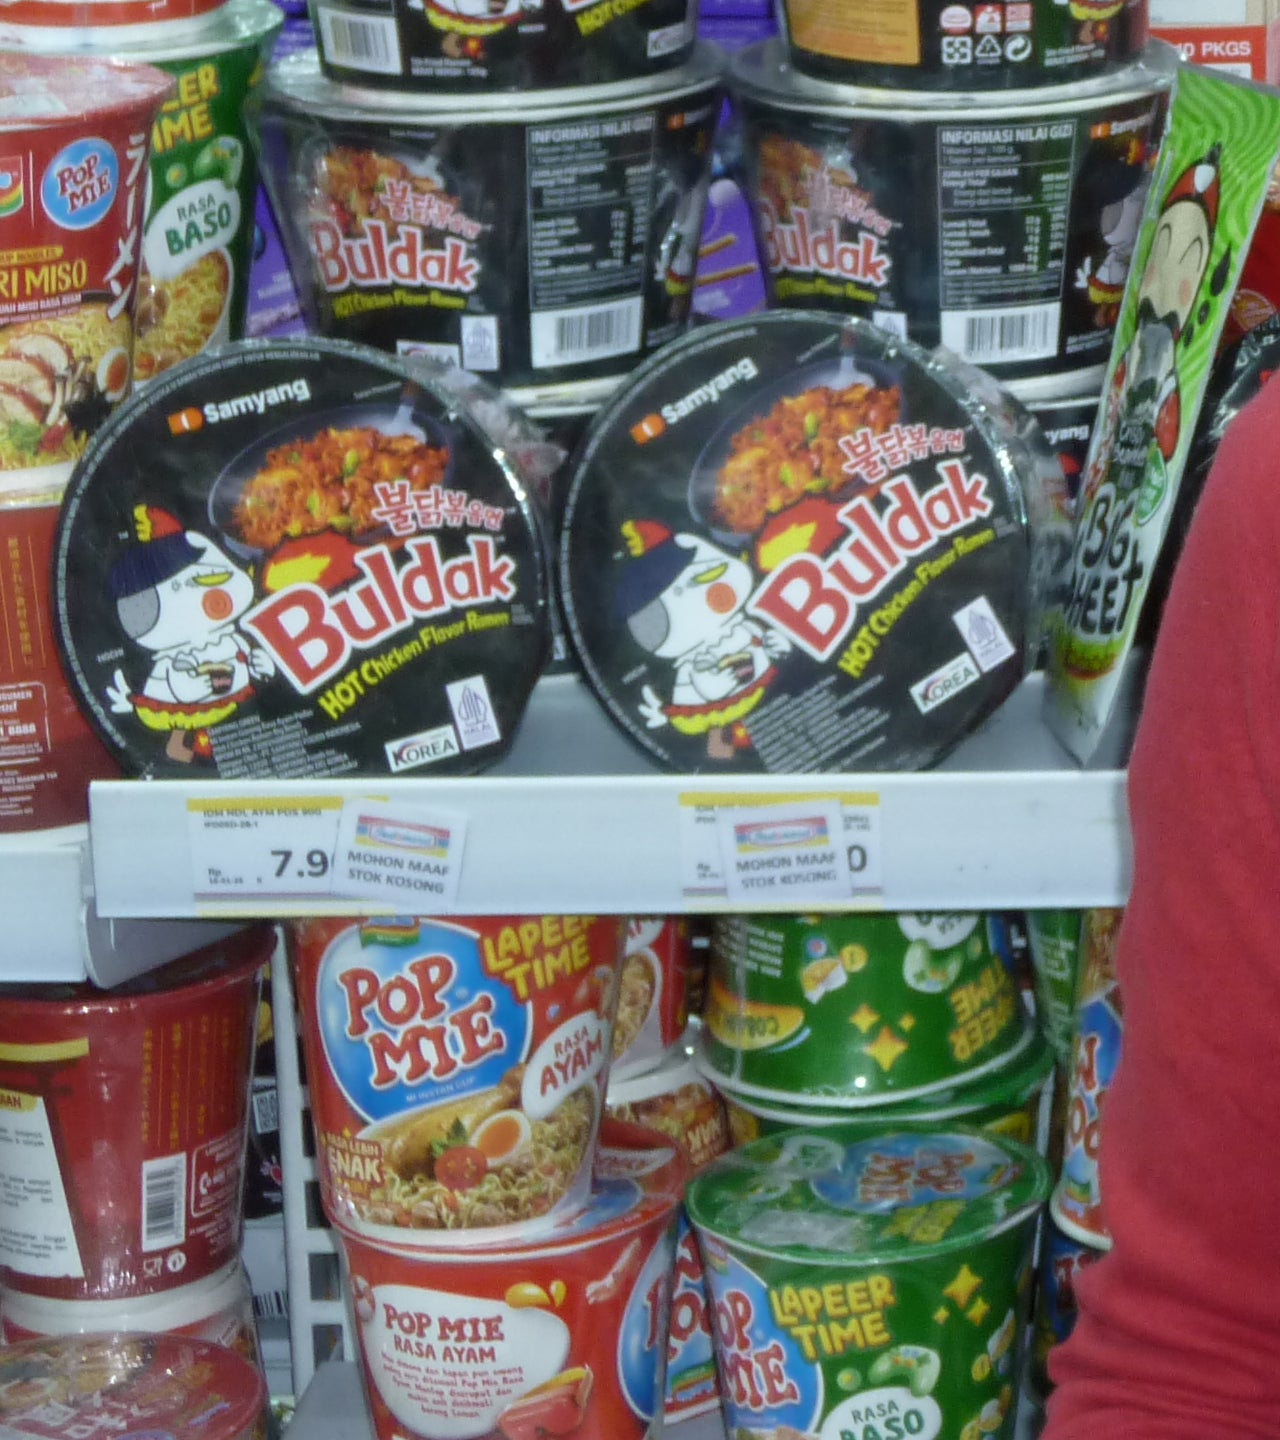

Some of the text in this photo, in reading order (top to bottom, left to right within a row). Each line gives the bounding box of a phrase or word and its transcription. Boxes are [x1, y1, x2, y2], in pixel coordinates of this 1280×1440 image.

[1201, 42, 1252, 57] PKGS
[153, 105, 214, 154] IME
[531, 121, 631, 144] INFORMASI NILAI
[942, 124, 1072, 144] INFORMASI NILAI GIZI
[56, 152, 100, 198] POP
[67, 174, 111, 213] MIE
[165, 203, 232, 257] BASO
[176, 194, 215, 222] RASA
[25, 258, 88, 296] MISO
[311, 218, 480, 291] Buldak
[204, 379, 312, 424] Samyang
[661, 357, 759, 424] Samyang
[840, 423, 964, 483] 불닭볶음면
[373, 481, 503, 537] 불닭볶음면
[747, 460, 994, 660] Buldak
[243, 534, 515, 694] Buldak
[838, 633, 883, 679] HOT
[872, 587, 924, 638] Chicken
[318, 668, 364, 720] HOT
[361, 637, 422, 688] Chicken
[420, 621, 467, 652] Flavor
[917, 665, 975, 708] KOREA
[391, 739, 456, 768] KOREA
[270, 849, 329, 878] 7.9
[347, 868, 445, 894] STOK KOSONG
[348, 850, 449, 876] MOHON MAAF
[736, 852, 835, 873] MOHON MAAF
[742, 869, 837, 889] STOK KOSONG
[503, 935, 592, 999] TIME
[338, 954, 456, 1038] POP
[367, 995, 505, 1087] MIE
[554, 1027, 589, 1055] RASA
[382, 1302, 505, 1343] POP MIE
[719, 1290, 753, 1351] OP
[771, 1275, 894, 1327] LAPEER
[394, 1334, 496, 1363] RASA AYAM
[792, 1314, 892, 1360] TIME
[852, 1399, 901, 1425] RASA
